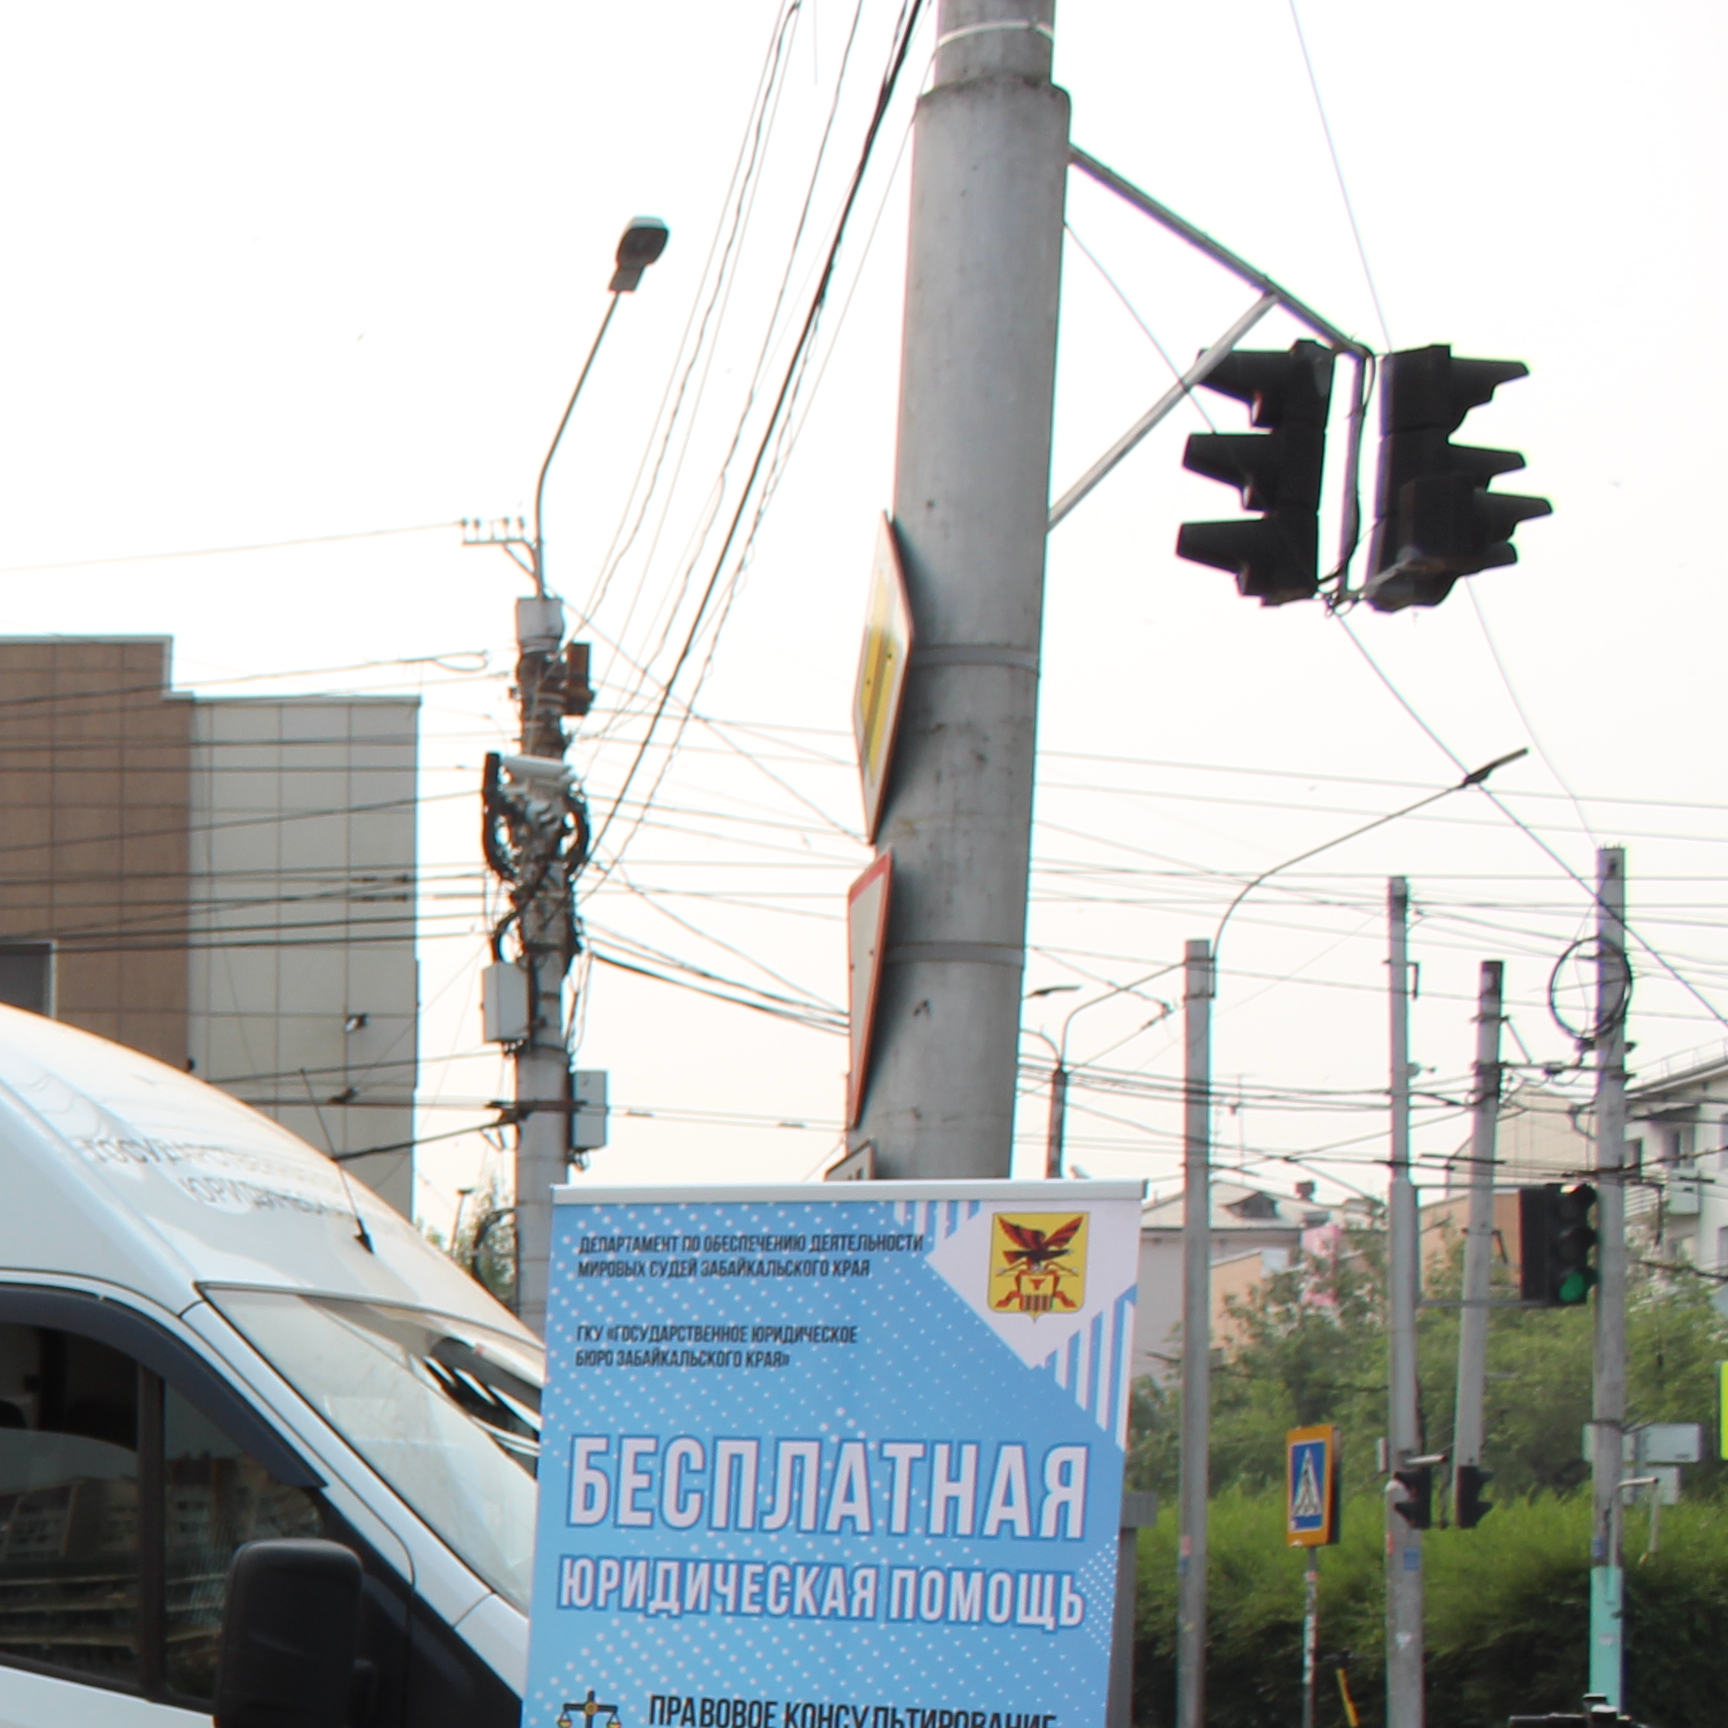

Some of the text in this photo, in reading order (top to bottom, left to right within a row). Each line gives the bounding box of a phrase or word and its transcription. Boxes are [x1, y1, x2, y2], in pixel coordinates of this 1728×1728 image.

[579, 1234, 924, 1254] ДЕПАРТАМЕНТ ПО ОБЕСПЕЧЕНИЮ ДЕЯТЕЛЬНОСТИ
[578, 1257, 870, 1278] МИРОВЫХ СУДЕЙ ЗАБАЙКАЛЬСКОГО КРАЯ
[577, 1326, 857, 1344] ГКУ «ГОСУДАРСТВЕННОЕ ЮРИДИЧЕСКОЕ
[576, 1348, 790, 1368] БЮРО ЗАБАЙКАЛЬСКОГО КРАЯ»
[568, 1436, 1088, 1540] БЕСПЛАТНАЯ
[560, 1557, 1086, 1632] ЮРИДИЧЕСКАЯ ПОМОЩЬ
